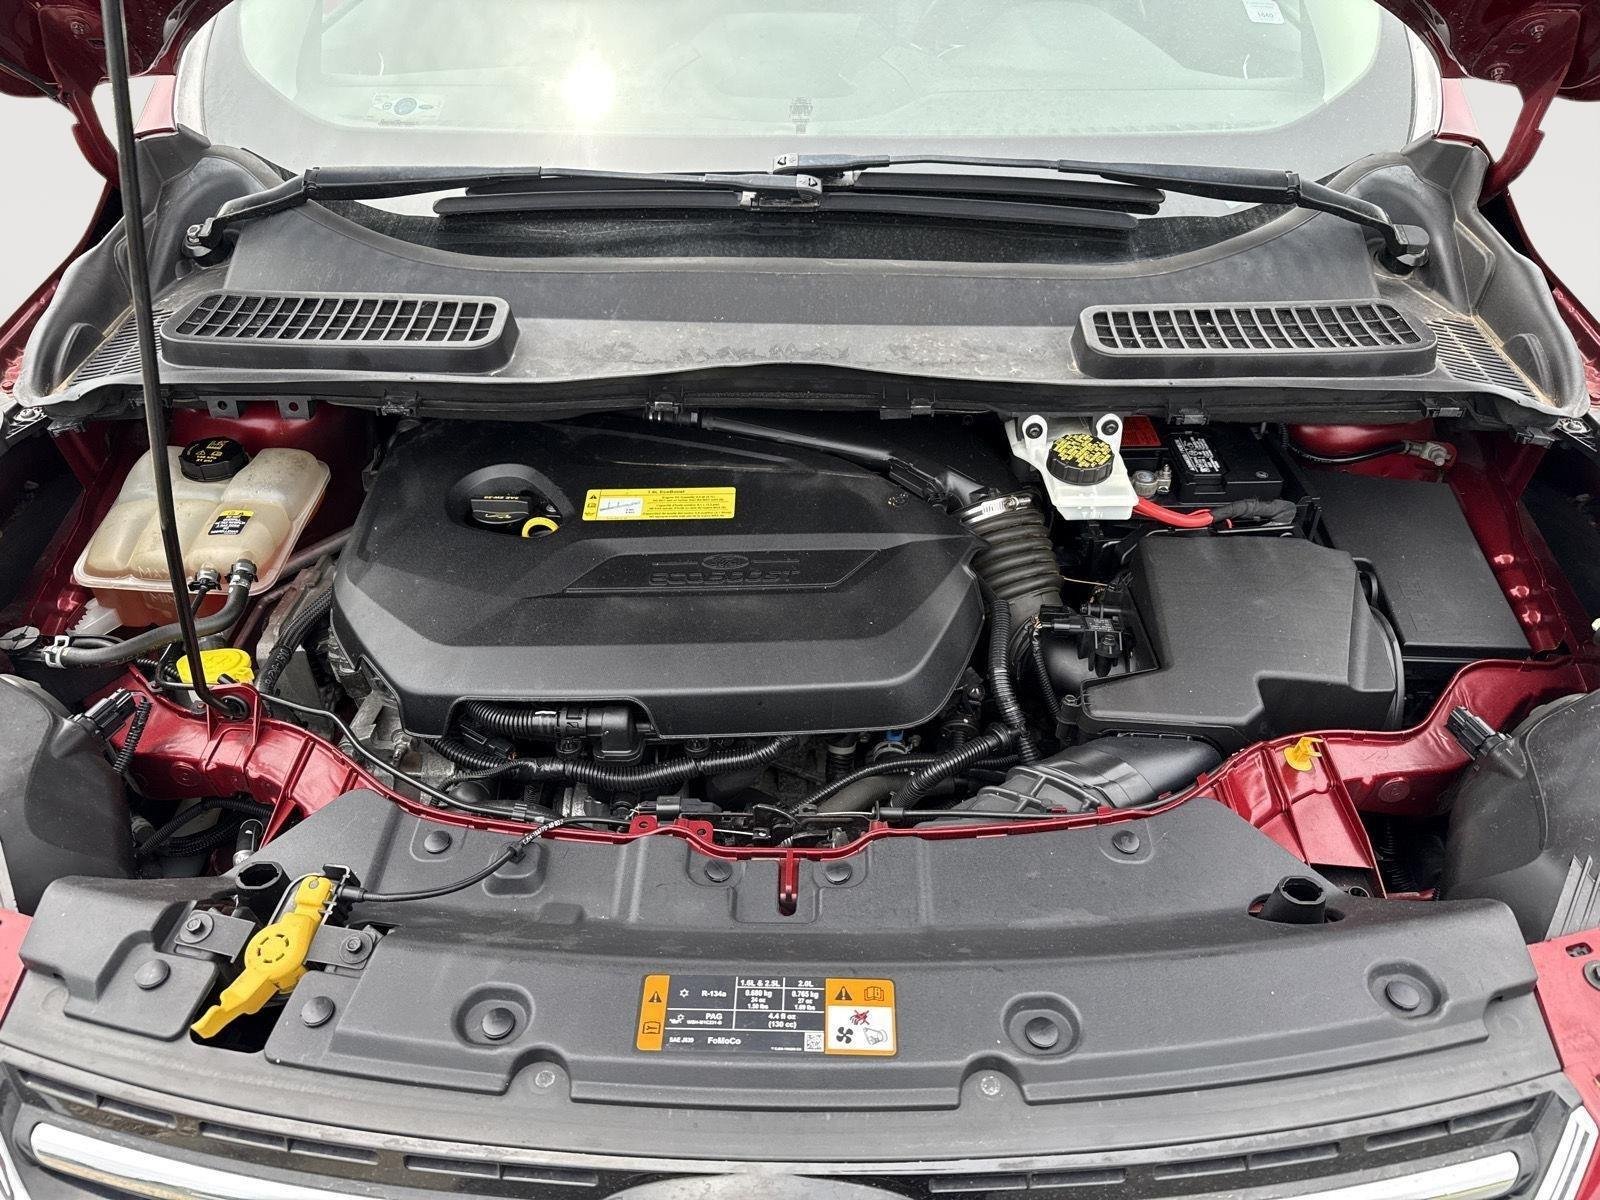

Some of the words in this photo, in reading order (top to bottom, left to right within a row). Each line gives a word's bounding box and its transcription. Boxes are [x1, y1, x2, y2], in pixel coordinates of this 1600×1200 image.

[740, 979, 756, 987] 1.6L
[764, 990, 773, 998] kg
[810, 991, 819, 999] kg
[785, 1021, 797, 1029] cc)
[707, 1037, 742, 1045] FoMoCo
